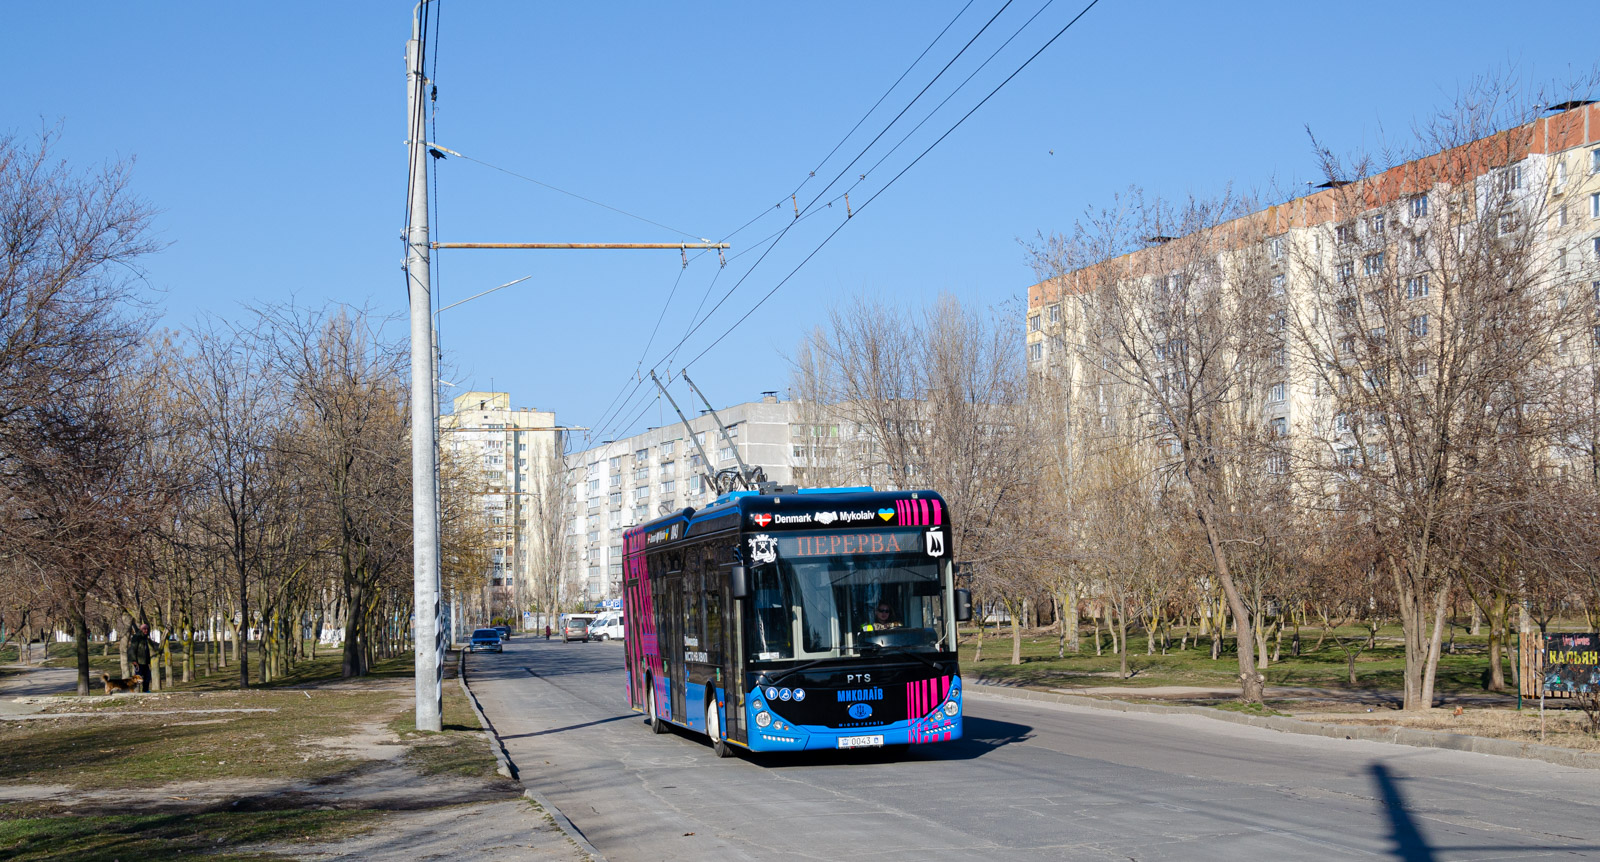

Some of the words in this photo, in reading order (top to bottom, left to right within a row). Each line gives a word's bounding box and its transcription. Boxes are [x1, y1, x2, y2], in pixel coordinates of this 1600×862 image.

[775, 514, 812, 524] Denmark
[840, 511, 875, 521] Mykolaiv
[797, 533, 900, 556] ПЕРЕРВА
[1550, 650, 1598, 664] КАЛЬЯН
[847, 674, 871, 684] PTS
[837, 686, 883, 702] МИКОЛАЇВ
[852, 736, 870, 746] 0043
